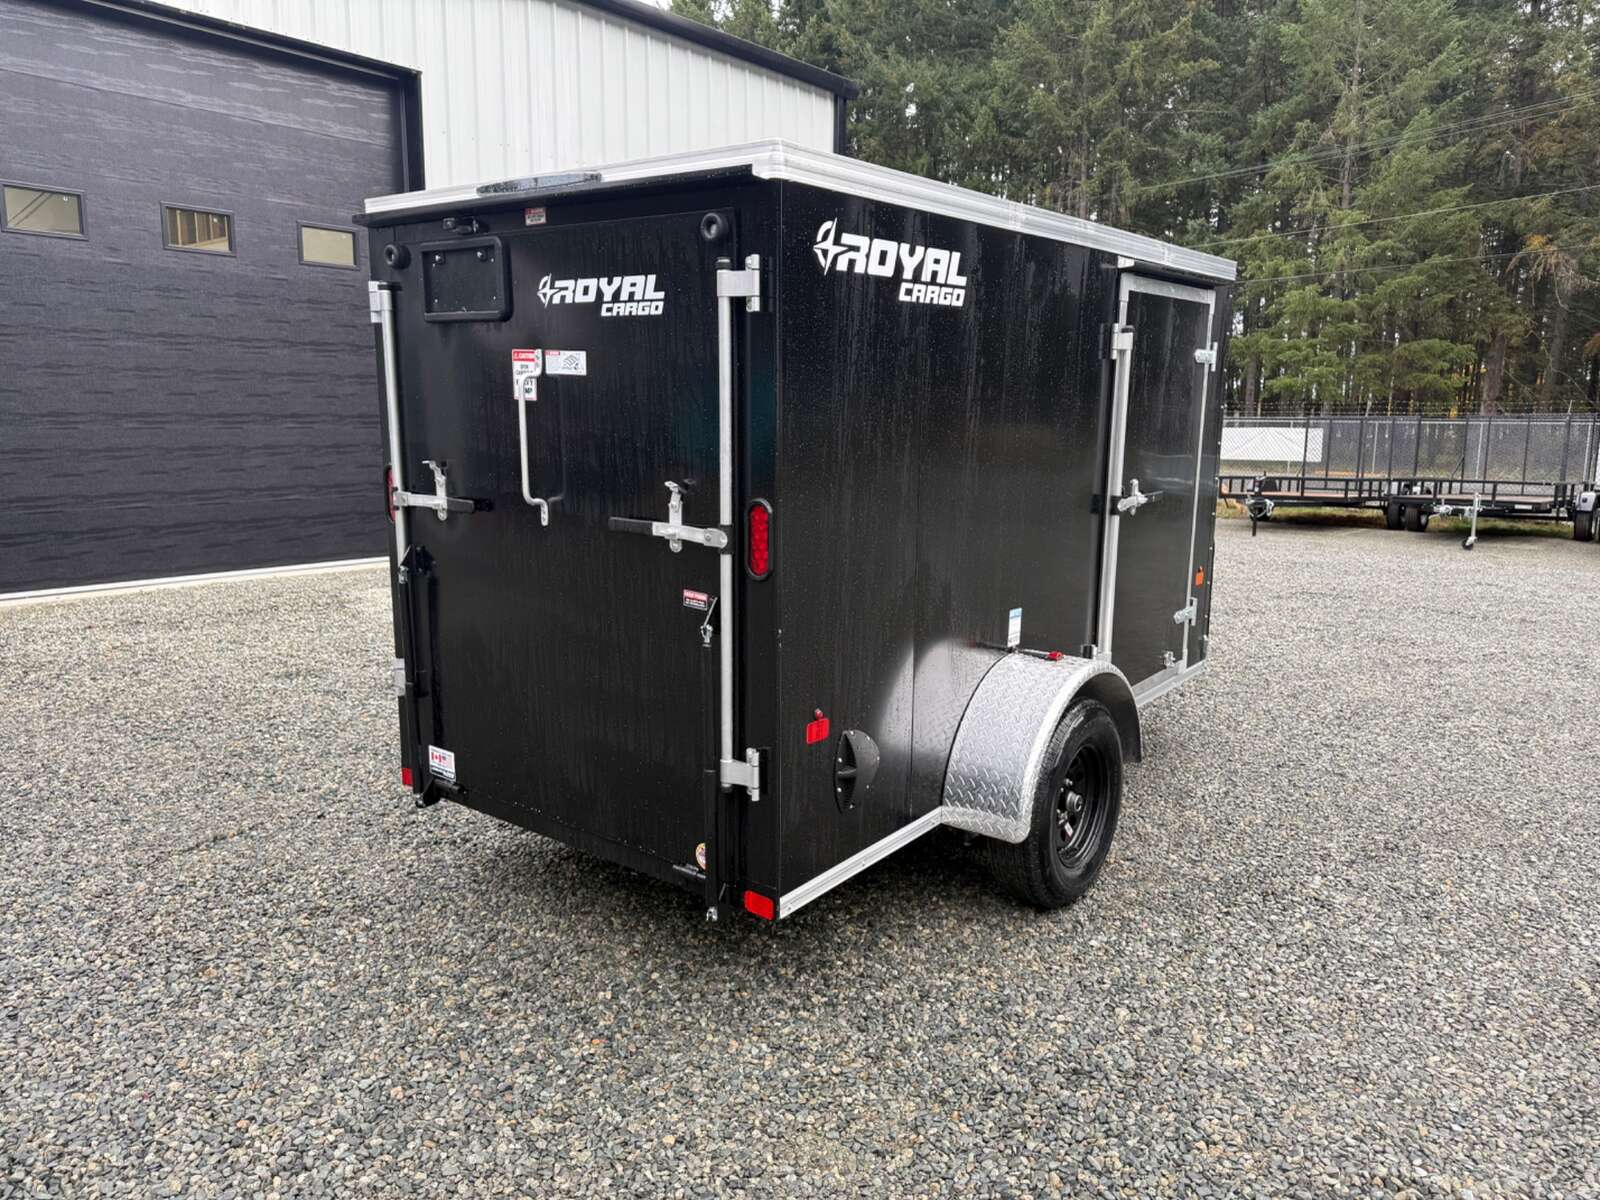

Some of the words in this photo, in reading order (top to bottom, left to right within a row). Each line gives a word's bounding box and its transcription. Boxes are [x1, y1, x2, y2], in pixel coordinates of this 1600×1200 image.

[836, 232, 967, 286] ROYAL
[552, 274, 665, 304] ROYAL
[898, 281, 966, 307] CARGO
[600, 300, 664, 317] CARGO
